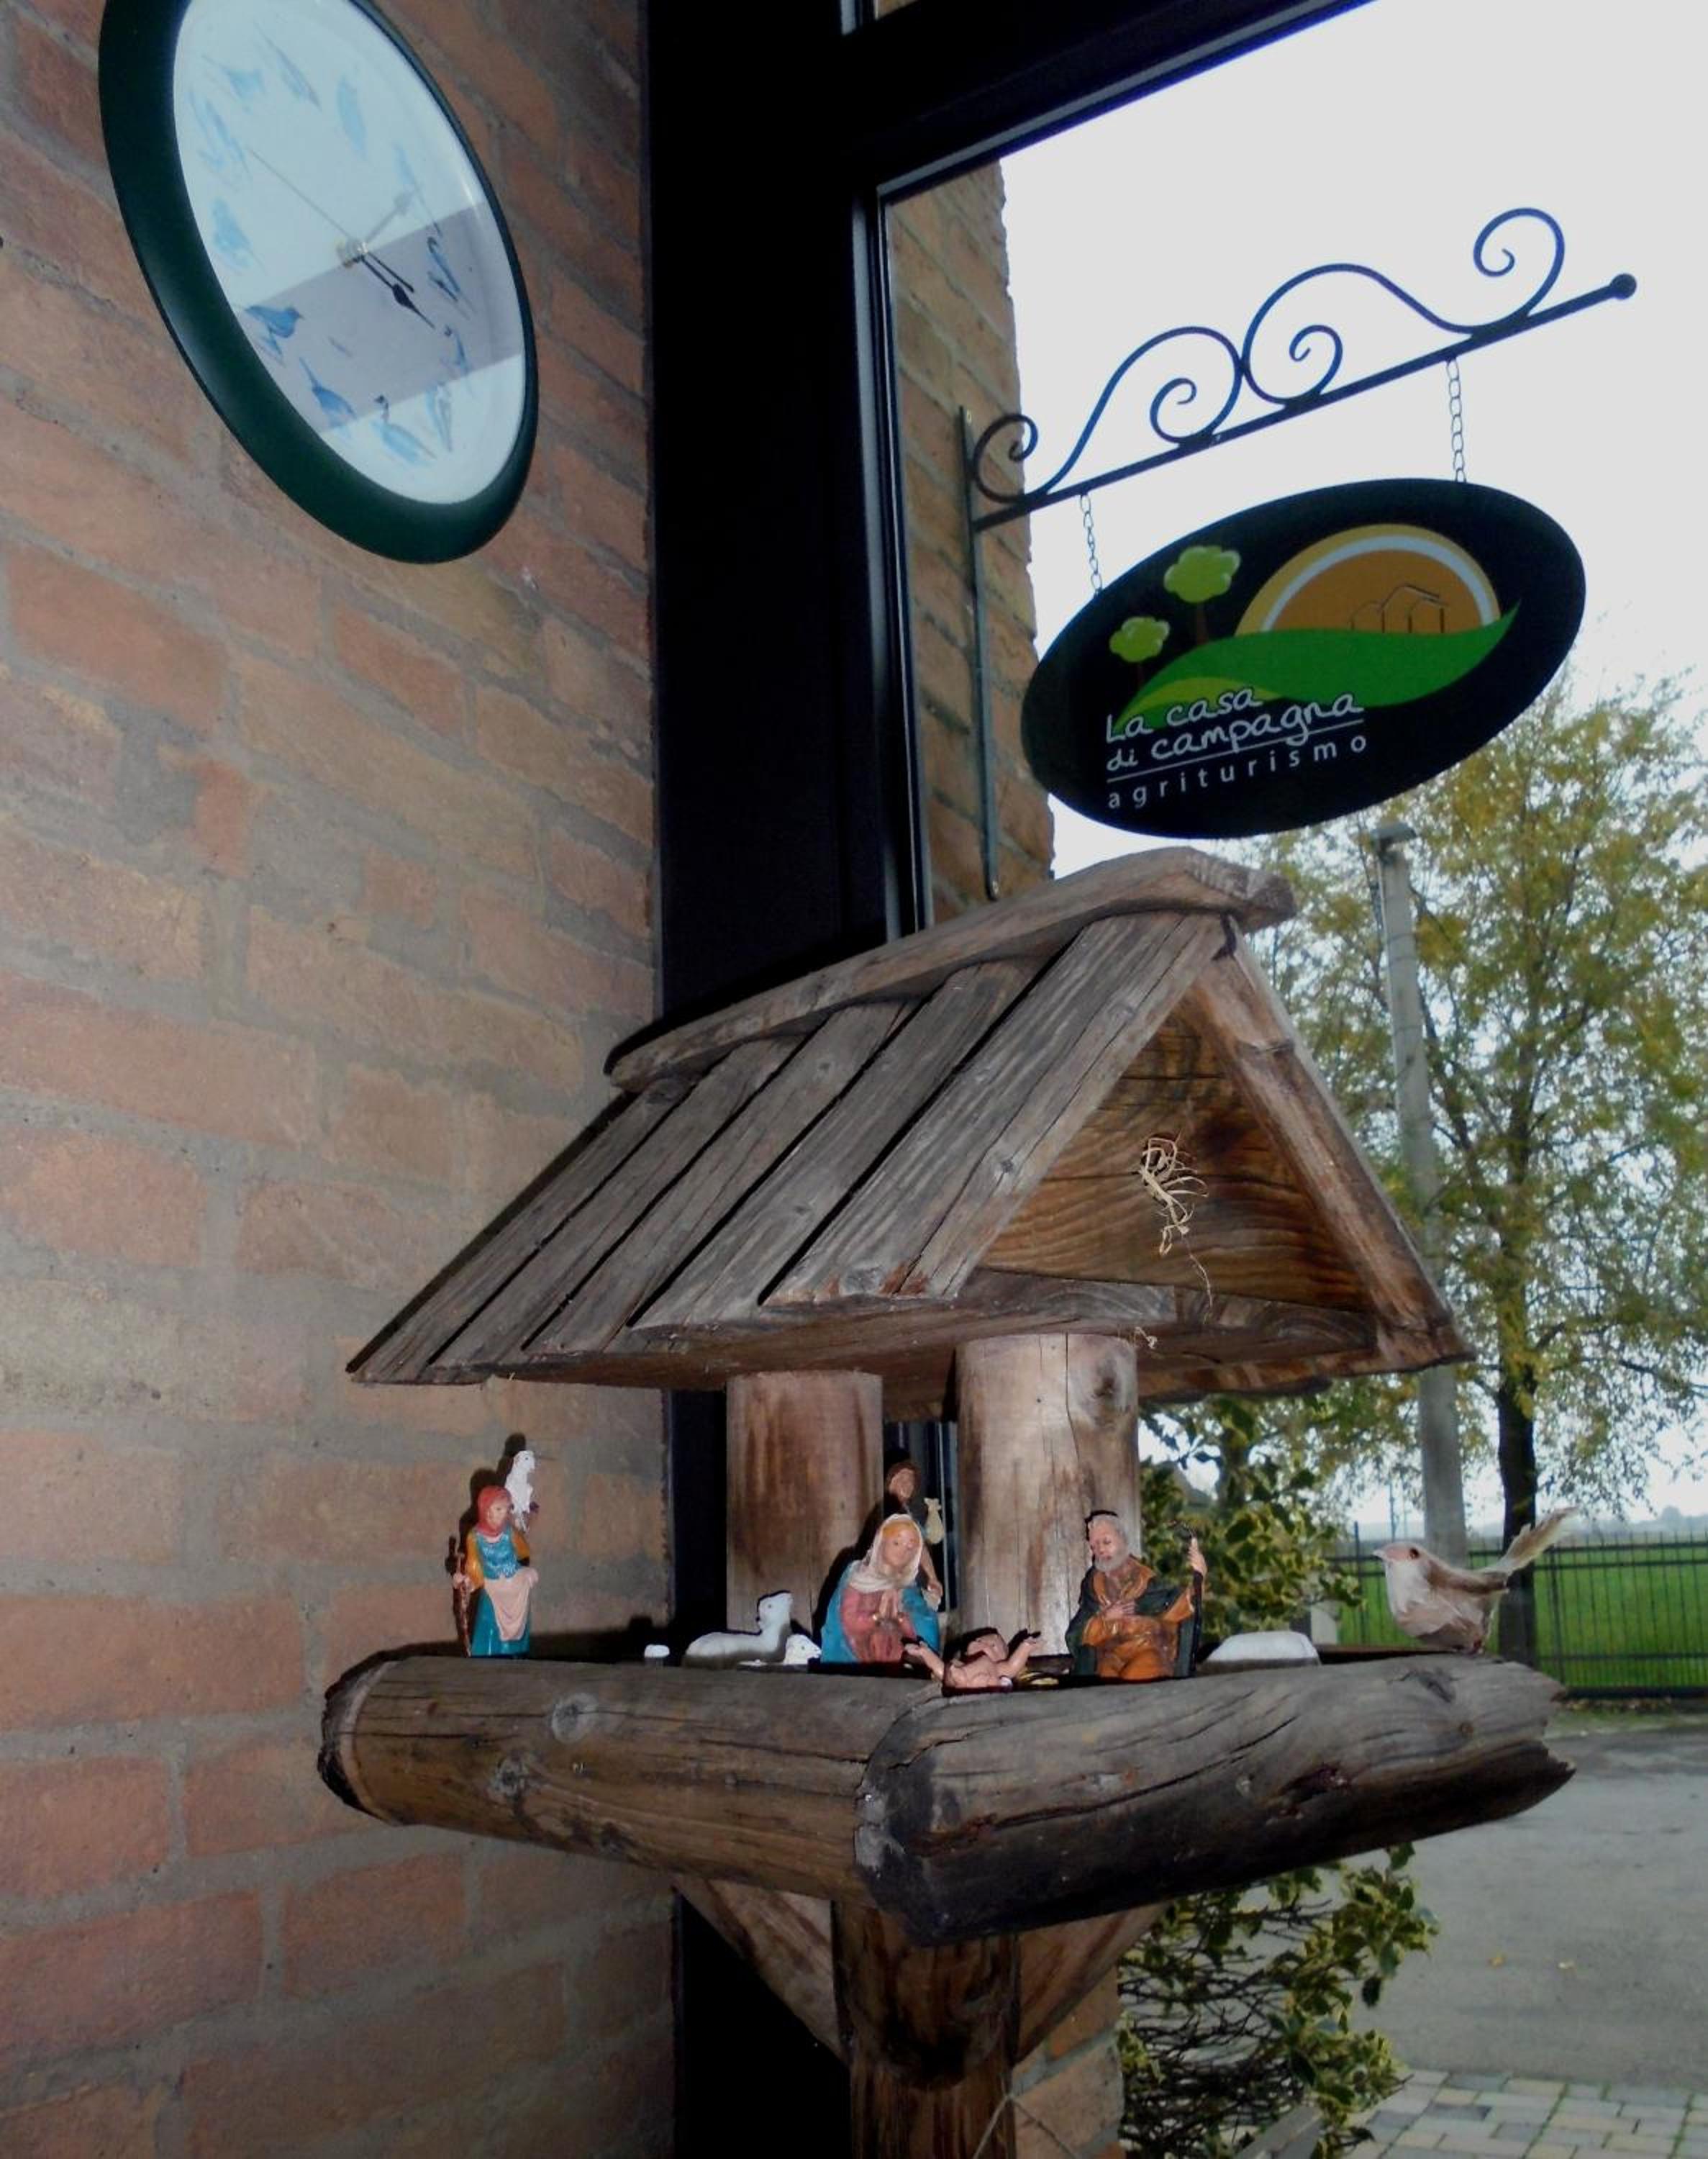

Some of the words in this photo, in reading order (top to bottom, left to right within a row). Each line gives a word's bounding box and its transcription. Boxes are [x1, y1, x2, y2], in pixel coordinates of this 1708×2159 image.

[1107, 715, 1153, 743] La
[1166, 687, 1263, 726] casa
[1107, 748, 1138, 771] di
[1151, 694, 1364, 760] campagna
[1108, 735, 1366, 809] agriturismo
